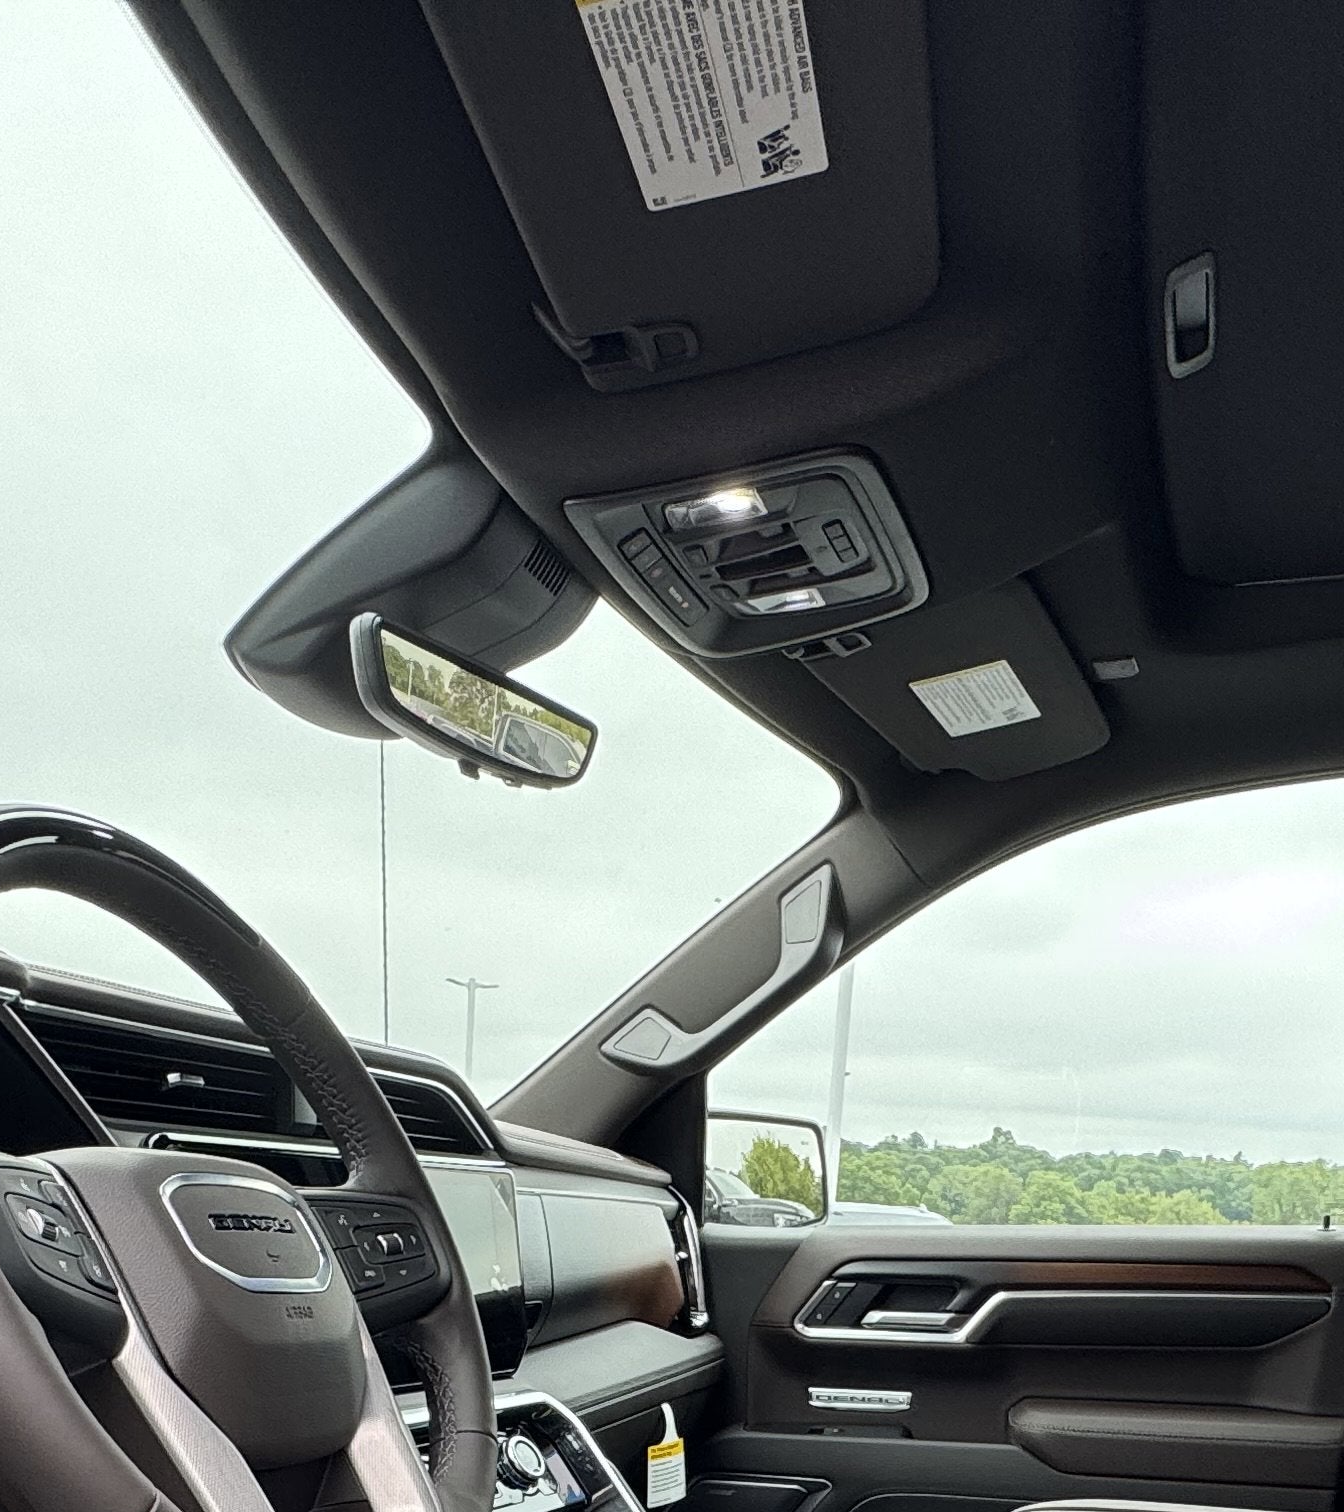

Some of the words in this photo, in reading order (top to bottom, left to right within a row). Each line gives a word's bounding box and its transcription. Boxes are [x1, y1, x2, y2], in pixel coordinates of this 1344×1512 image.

[788, 7, 805, 53] ADVANCED
[694, 51, 710, 72] SACS
[796, 55, 808, 70] AIR
[799, 71, 812, 93] BAGS
